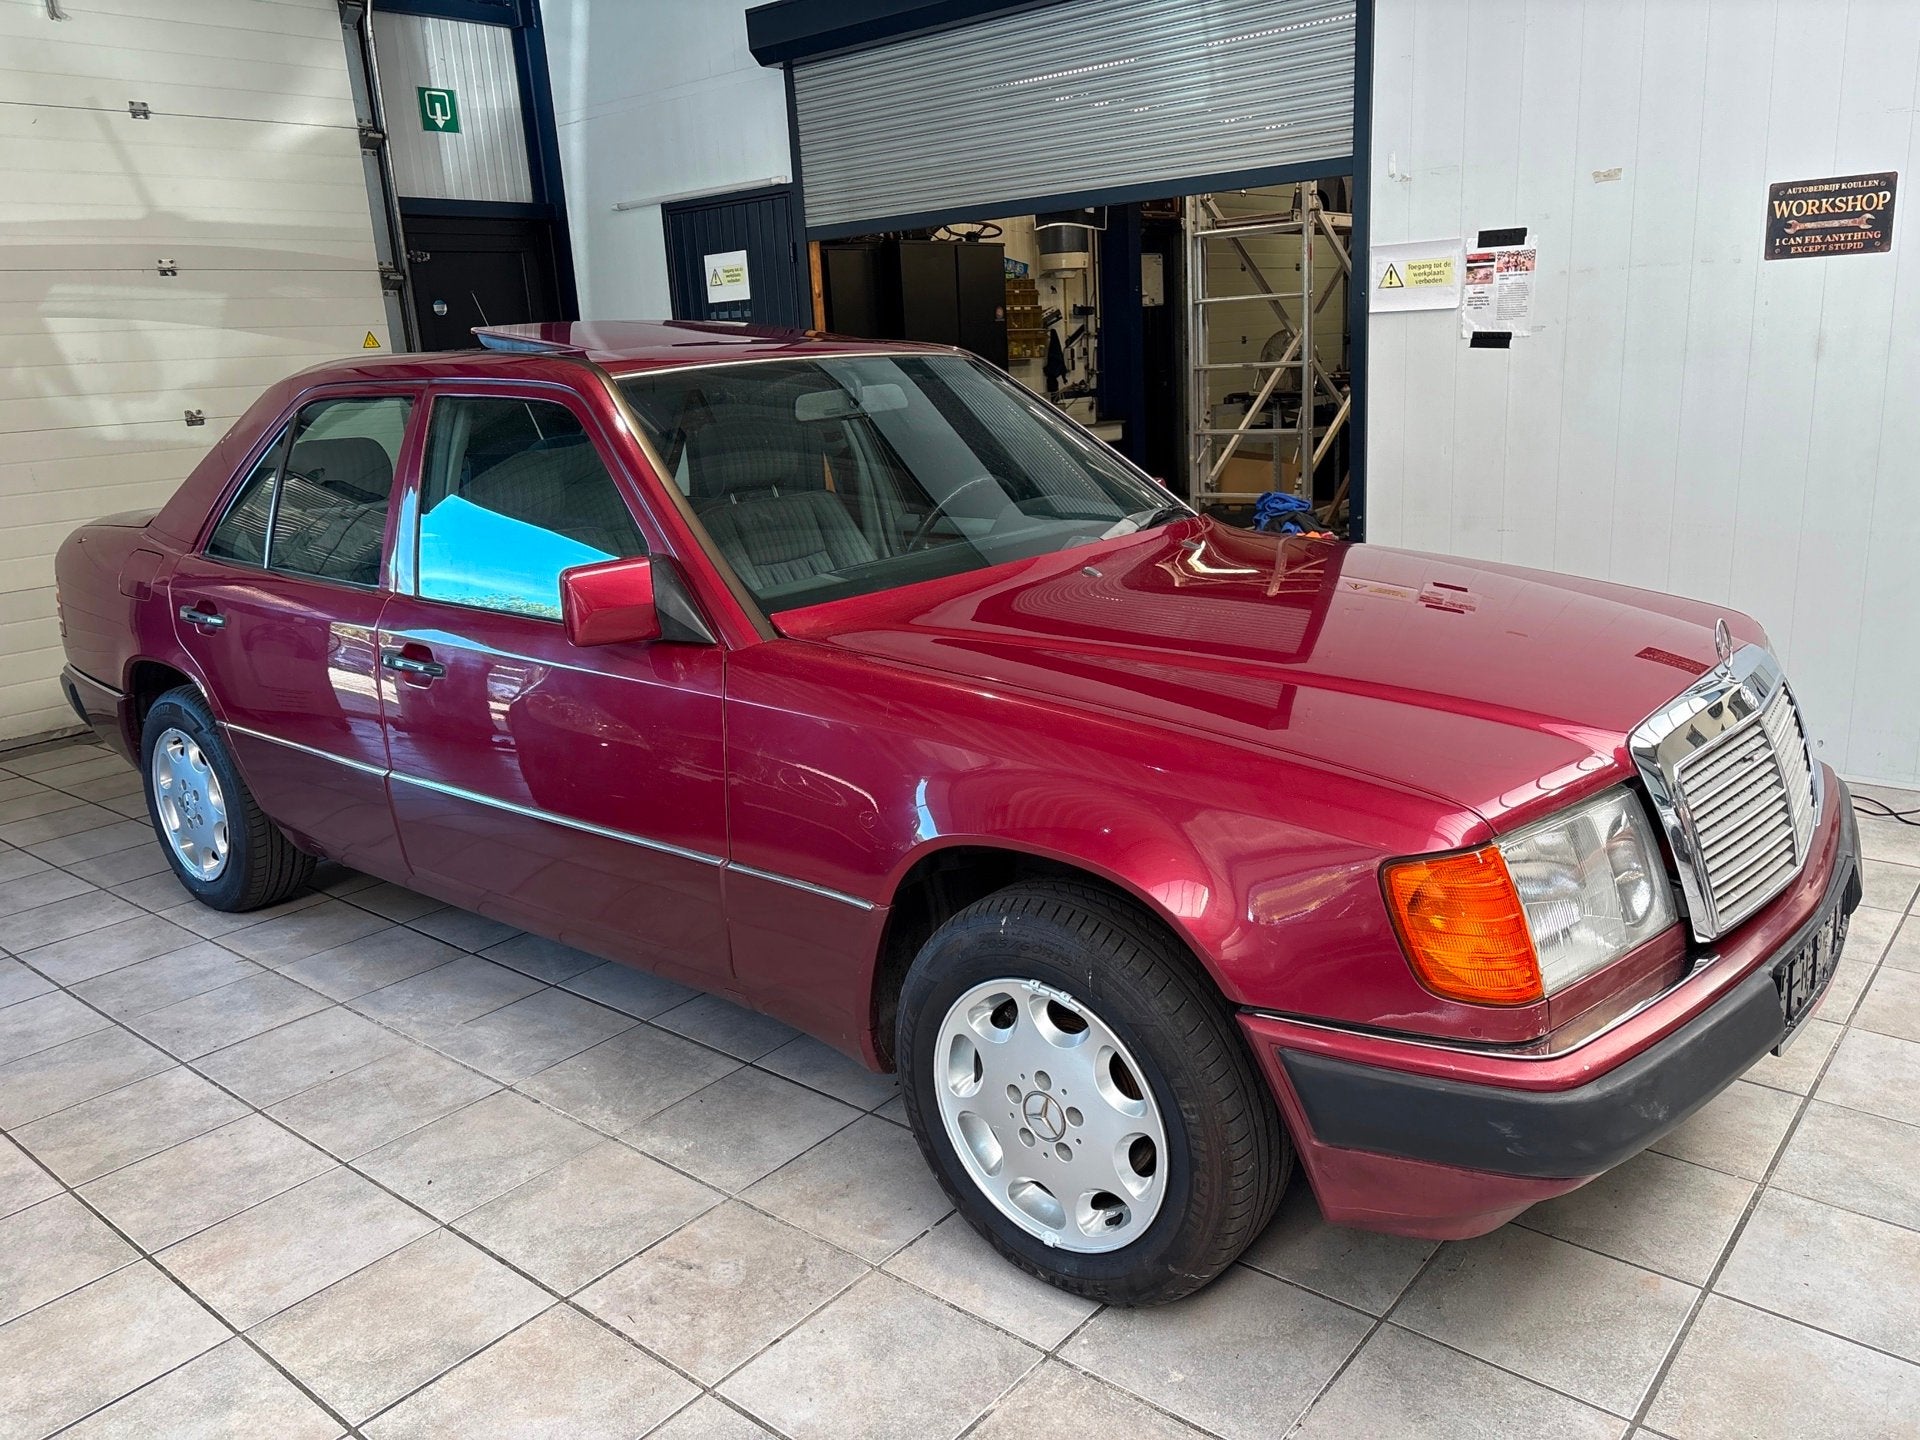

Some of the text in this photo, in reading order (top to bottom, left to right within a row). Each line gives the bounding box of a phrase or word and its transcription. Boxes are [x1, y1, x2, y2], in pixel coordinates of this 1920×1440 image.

[1787, 179, 1880, 195] AUTOBEDRIJF KOULLEN
[1773, 191, 1891, 219] WORKSHOP
[1775, 230, 1882, 246] I CAN FIX ANYTHING
[1790, 241, 1864, 254] EXCEPT STUPID
[1407, 262, 1432, 271] Toegang
[1412, 269, 1446, 277] werkplaats
[1415, 277, 1443, 285] verboden
